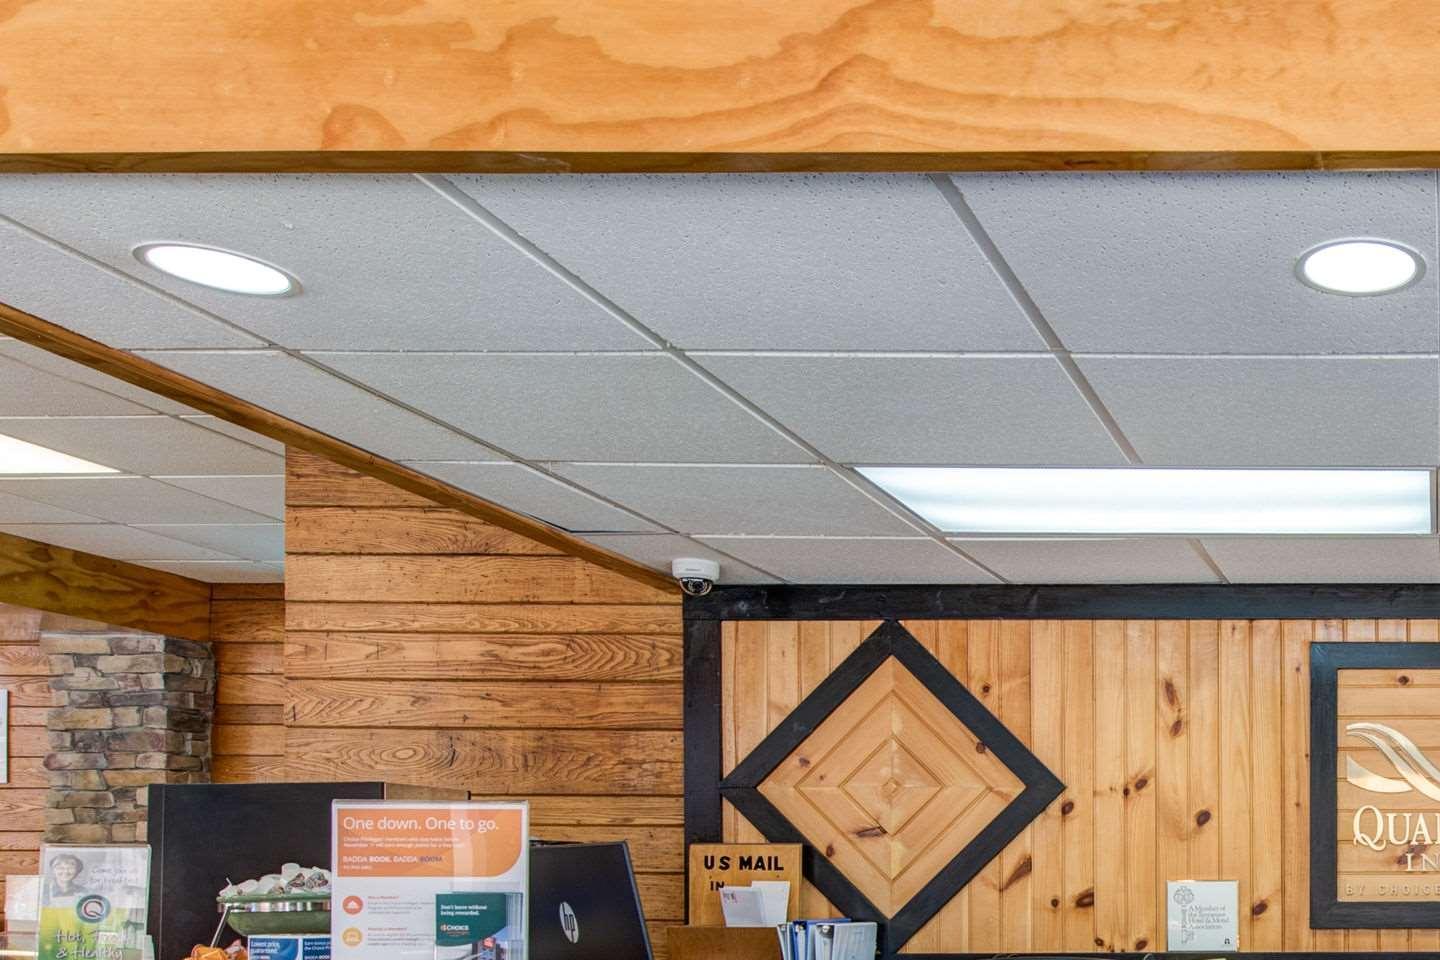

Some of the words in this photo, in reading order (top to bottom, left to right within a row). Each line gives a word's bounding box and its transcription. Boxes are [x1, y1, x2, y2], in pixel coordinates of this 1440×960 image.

[343, 817, 374, 830] One
[377, 817, 422, 830] down.
[425, 817, 456, 830] One
[459, 818, 474, 830] to
[477, 819, 499, 833] go.
[738, 855, 784, 871] MAIL
[1346, 884, 1366, 896] BY
